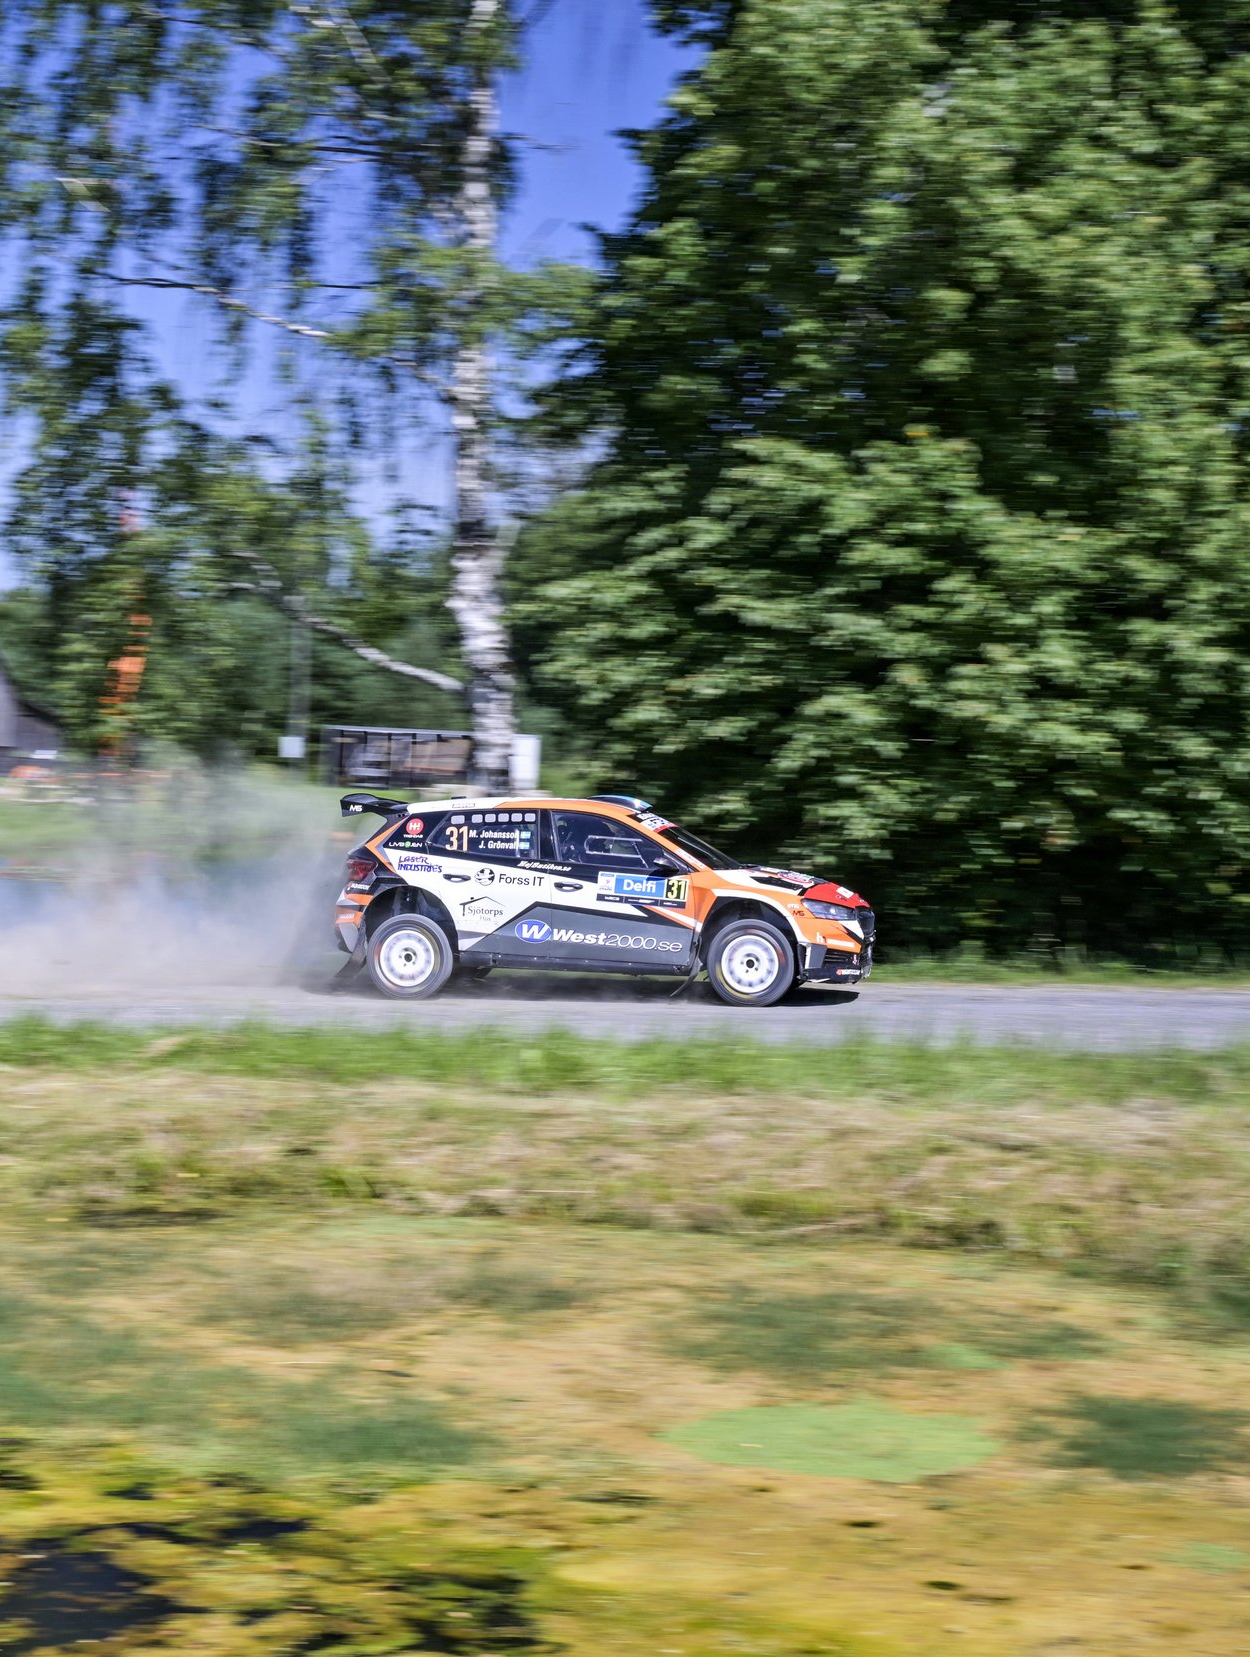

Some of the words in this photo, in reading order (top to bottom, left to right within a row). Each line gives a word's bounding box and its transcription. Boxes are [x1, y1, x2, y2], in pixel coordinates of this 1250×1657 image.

[445, 826, 468, 852] 31
[468, 829, 479, 838] M.
[478, 840, 486, 849] J.
[397, 863, 443, 873] INDUSTRIES
[498, 873, 530, 886] Forss
[532, 876, 545, 887] IT
[623, 879, 657, 893] Delfi
[667, 879, 686, 900] 31
[467, 905, 504, 917] Sjötorps
[521, 922, 550, 940] W
[553, 928, 683, 952] West2000.se
